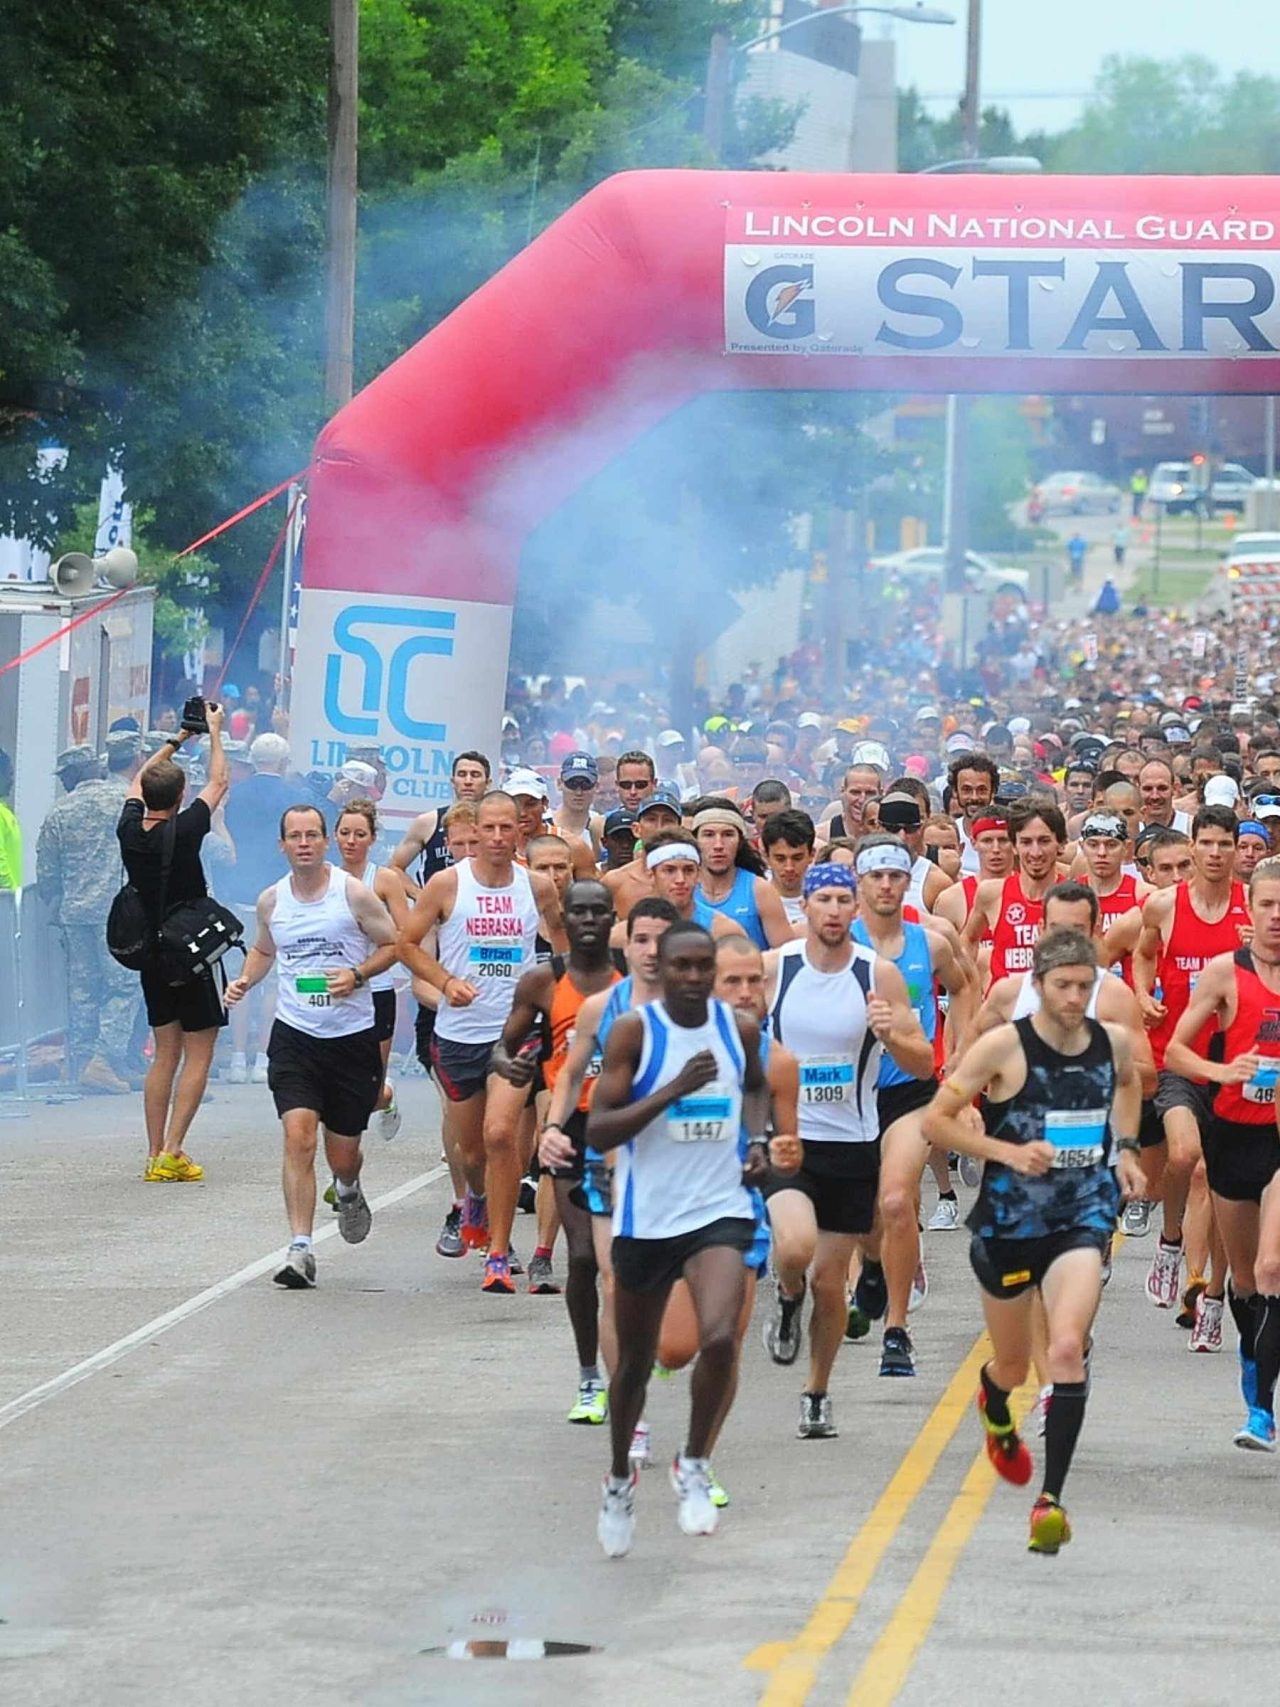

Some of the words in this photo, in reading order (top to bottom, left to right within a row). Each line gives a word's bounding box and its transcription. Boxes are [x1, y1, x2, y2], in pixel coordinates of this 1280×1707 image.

[744, 211, 915, 238] LINCOLN
[927, 213, 1126, 240] NATIONAL
[1136, 215, 1275, 242] GUARD
[730, 342, 790, 352] Presented
[793, 343, 806, 354] by
[475, 895, 514, 914] TEAM
[465, 917, 524, 937] NEBRASKA
[478, 962, 513, 978] 2060
[1174, 956, 1201, 971] TEAM
[308, 993, 331, 1007] 401
[804, 1066, 842, 1084] Mark
[805, 1085, 844, 1103] 1309
[682, 1121, 724, 1140] 1447
[1055, 1148, 1096, 1166] 4654
